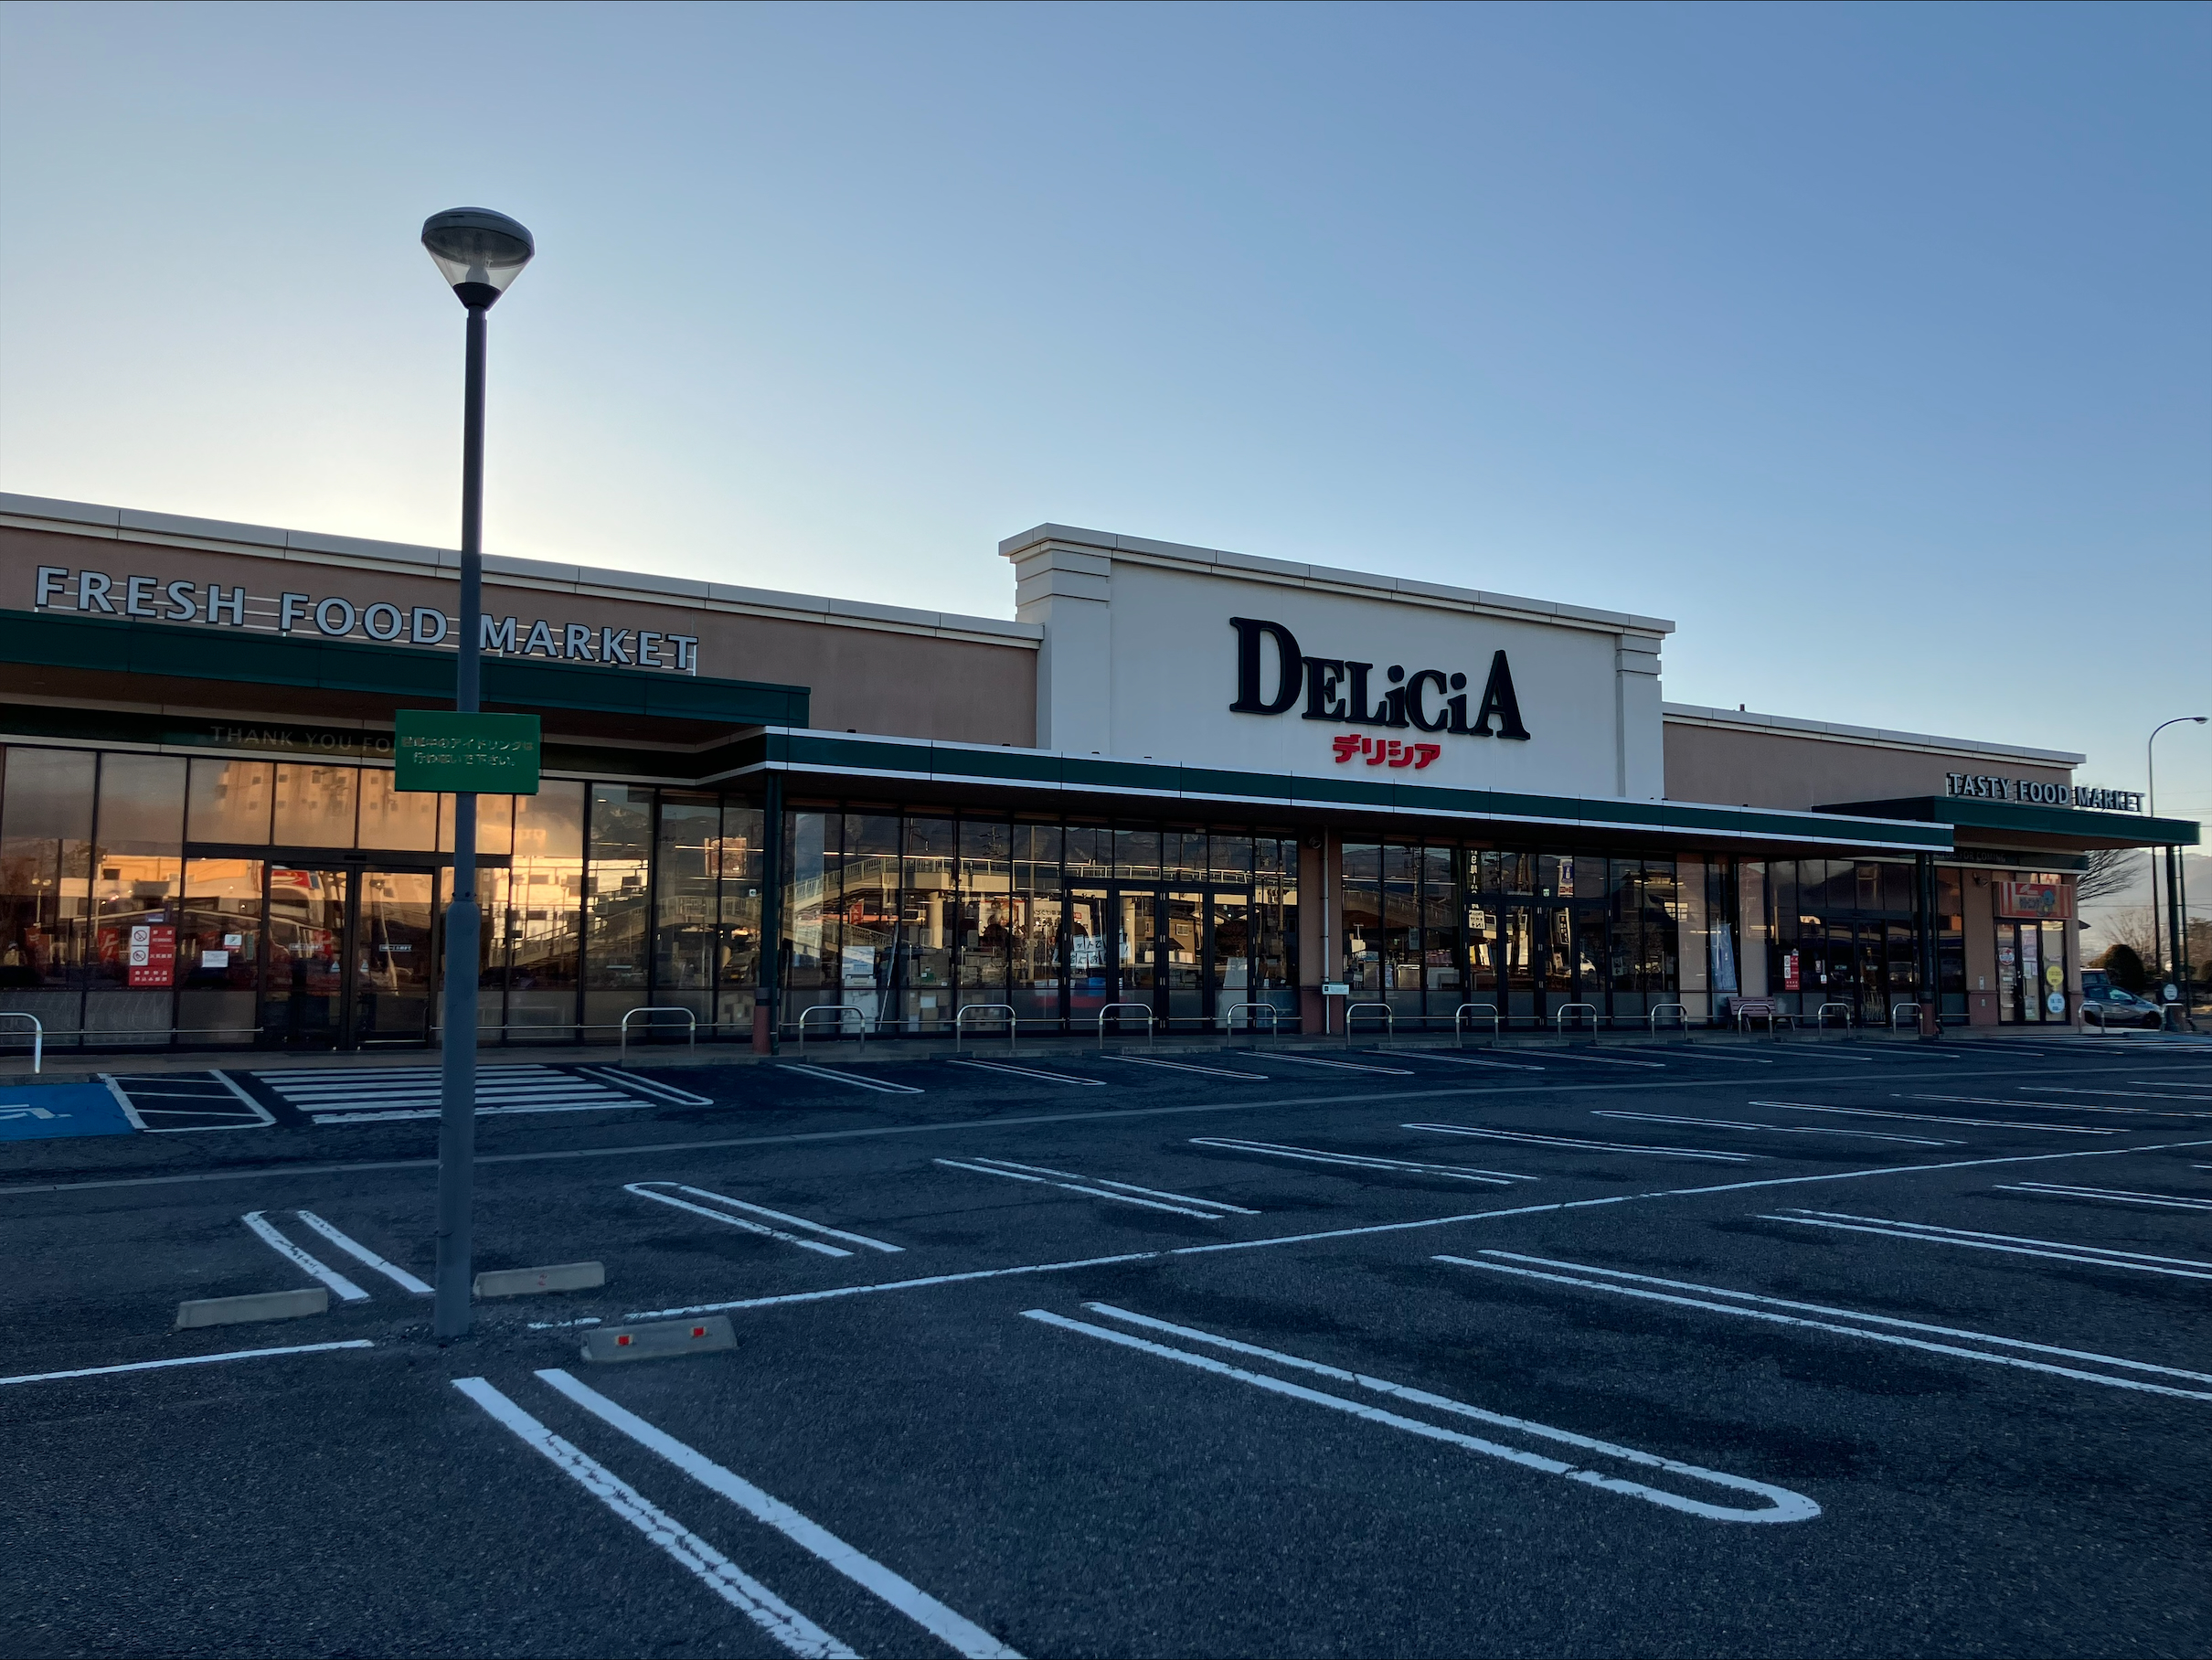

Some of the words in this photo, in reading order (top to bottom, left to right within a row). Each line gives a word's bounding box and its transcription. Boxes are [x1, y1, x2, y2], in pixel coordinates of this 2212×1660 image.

[37, 565, 246, 626] FRESH
[280, 592, 448, 644] FOOD
[480, 613, 699, 670] MARKET
[209, 725, 293, 747] THANK
[305, 732, 352, 750] YOU
[363, 736, 396, 753] FO
[1333, 734, 1441, 770] デリシア
[1946, 771, 2011, 799] TASTY
[2016, 779, 2068, 804] FOOD
[2075, 785, 2145, 812] MARKET
